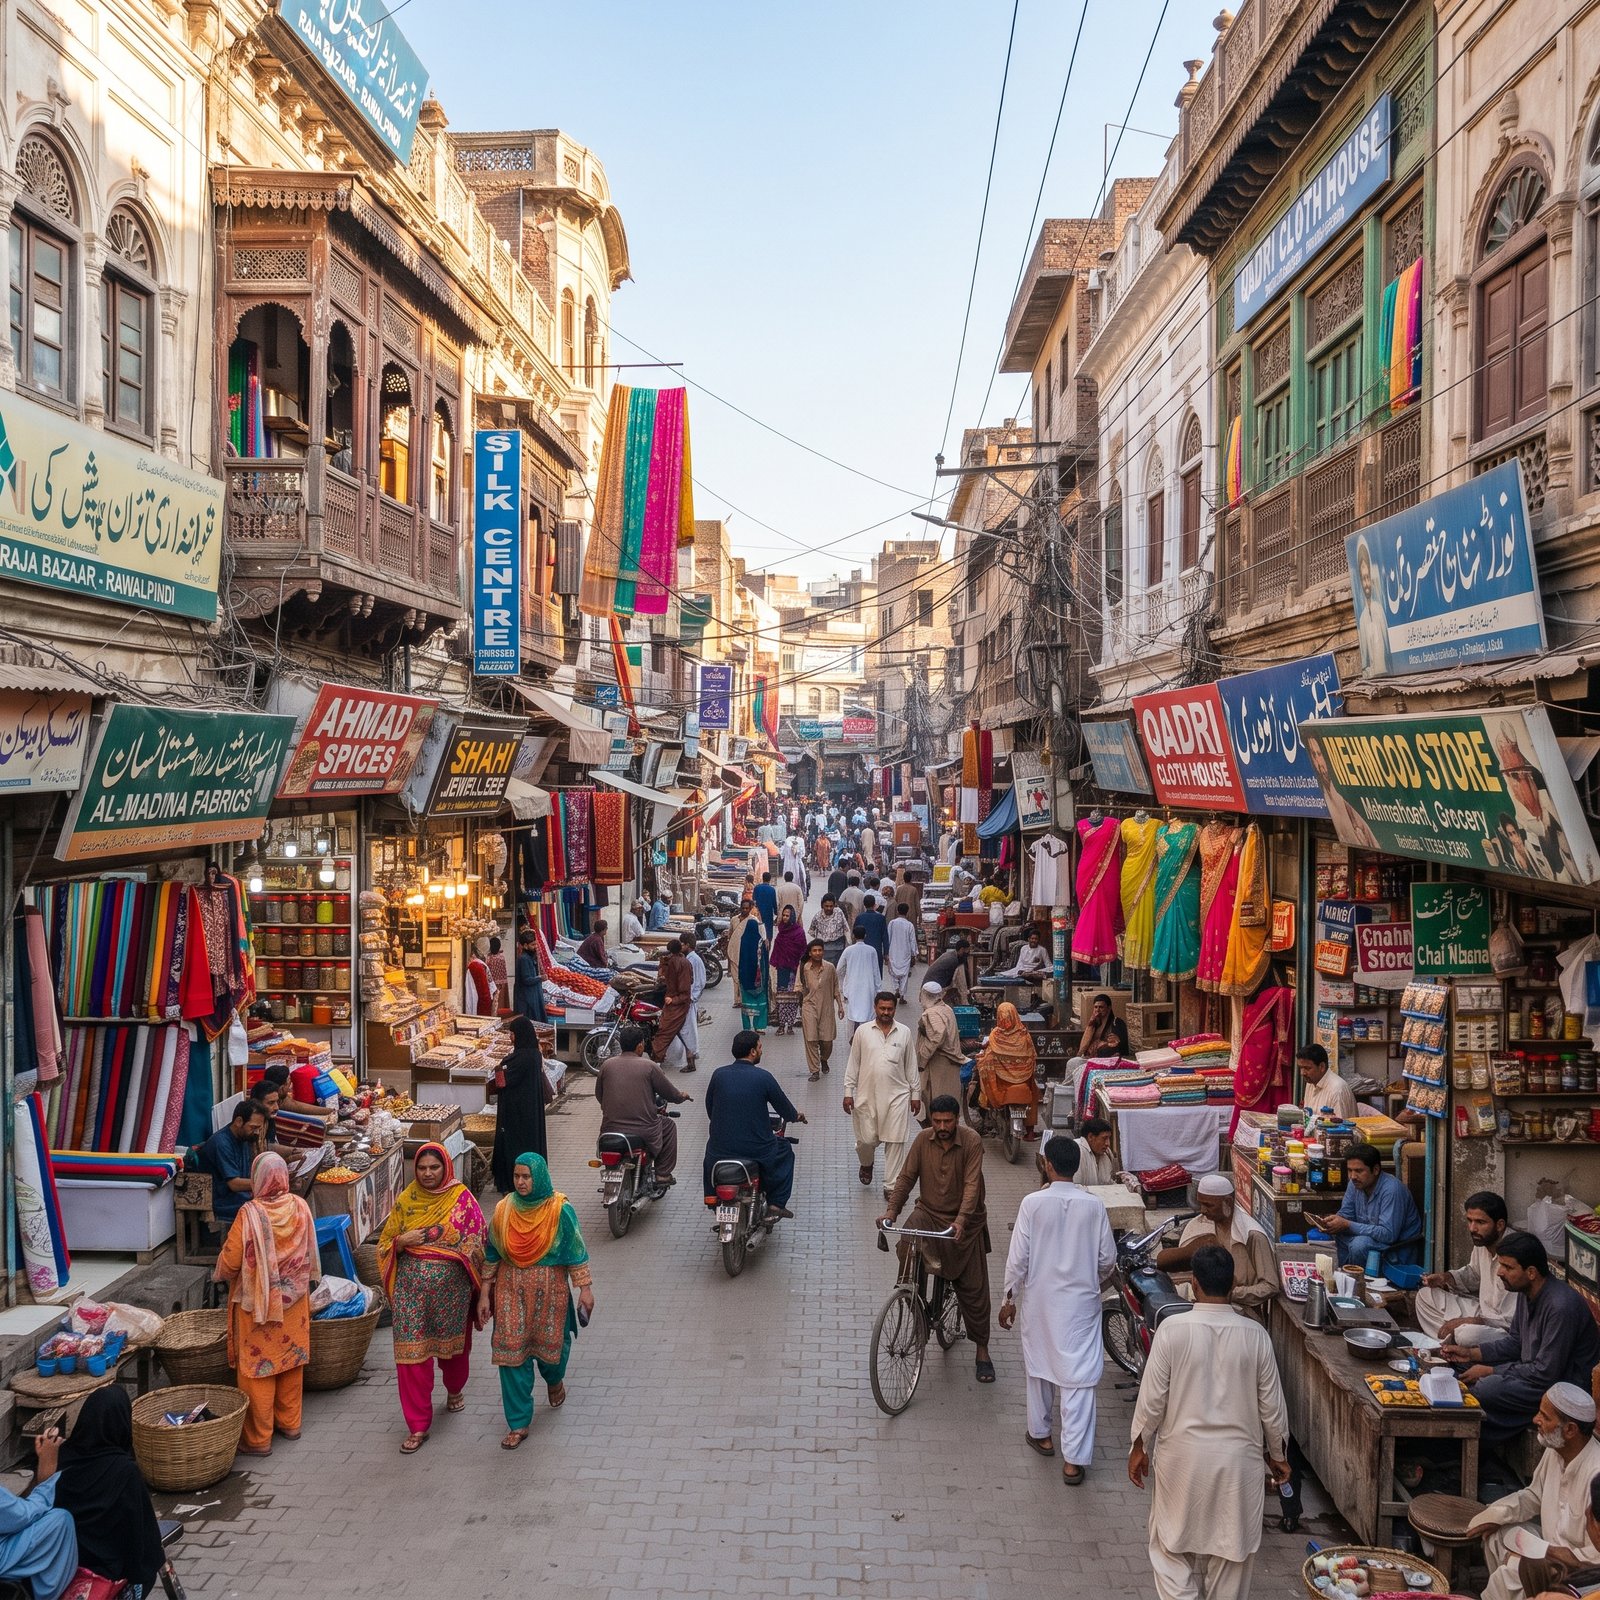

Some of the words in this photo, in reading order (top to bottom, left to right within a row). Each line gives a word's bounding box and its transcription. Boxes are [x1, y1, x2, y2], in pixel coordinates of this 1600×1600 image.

[1278, 176, 1322, 262] CLOTH
[1326, 110, 1382, 212] HOUSE
[483, 435, 514, 511] SILK
[0, 543, 38, 576] RAJA
[42, 554, 97, 590] BAZAAR
[106, 570, 175, 606] RAWALPINDI
[482, 528, 513, 646] CENTRE
[313, 697, 414, 742] AHMAD
[1142, 699, 1224, 758] QADRI
[318, 743, 396, 775] SPICES
[450, 740, 517, 775] SHAHI
[1156, 762, 1191, 786] CLOTH
[1188, 760, 1233, 788] HOUSE
[1321, 734, 1423, 790] MEHMOOD
[1415, 730, 1503, 793] STORE
[88, 791, 188, 824] AL-MADINA
[189, 788, 253, 816] FABRICS
[1433, 800, 1490, 840] Grocery
[1417, 943, 1445, 966] Chai
